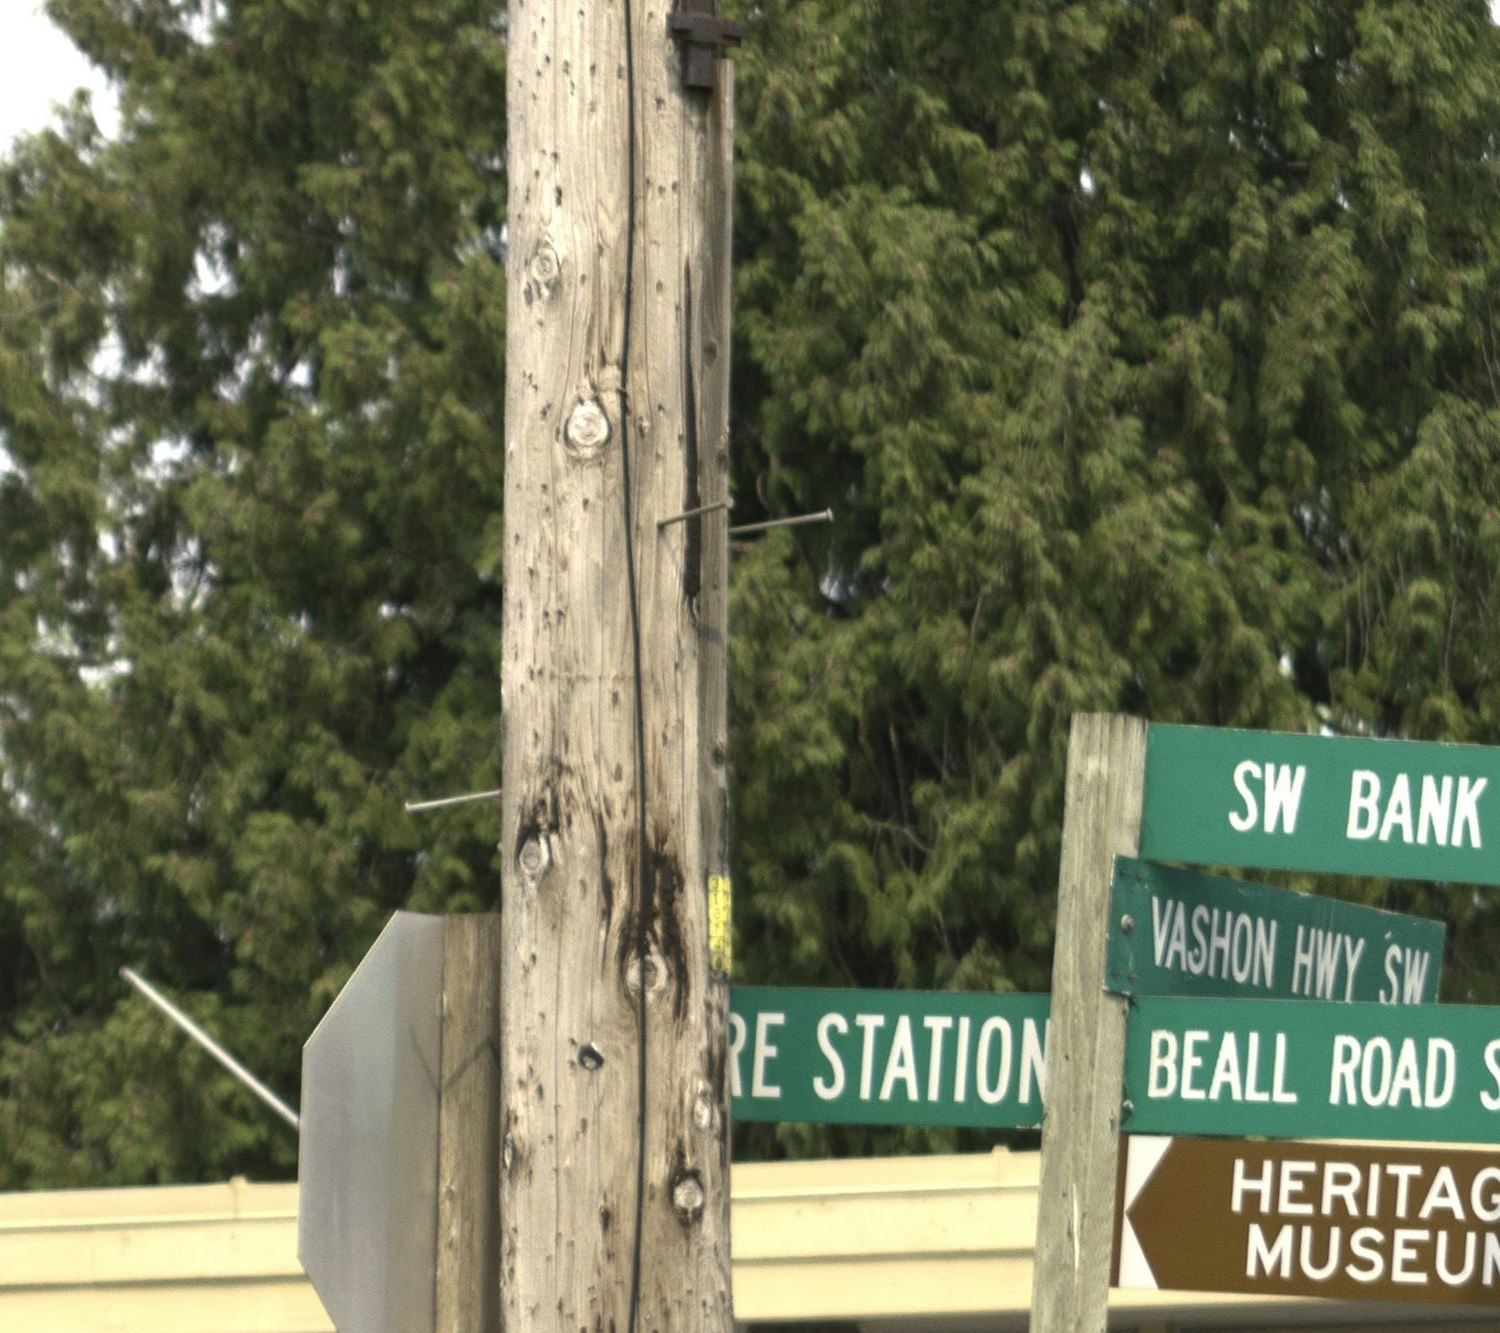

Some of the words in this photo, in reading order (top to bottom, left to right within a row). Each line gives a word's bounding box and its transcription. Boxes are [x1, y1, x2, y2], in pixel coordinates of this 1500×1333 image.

[1228, 760, 1306, 835] SW
[1346, 769, 1488, 849] BANK
[1151, 896, 1278, 989] VASHON
[1291, 942, 1365, 1003] HWY
[1379, 945, 1431, 1005] SW
[728, 1011, 786, 1099] RE
[813, 1012, 1052, 1106] STATION
[1148, 1030, 1297, 1105] BEALL
[1330, 1035, 1456, 1111] ROAD
